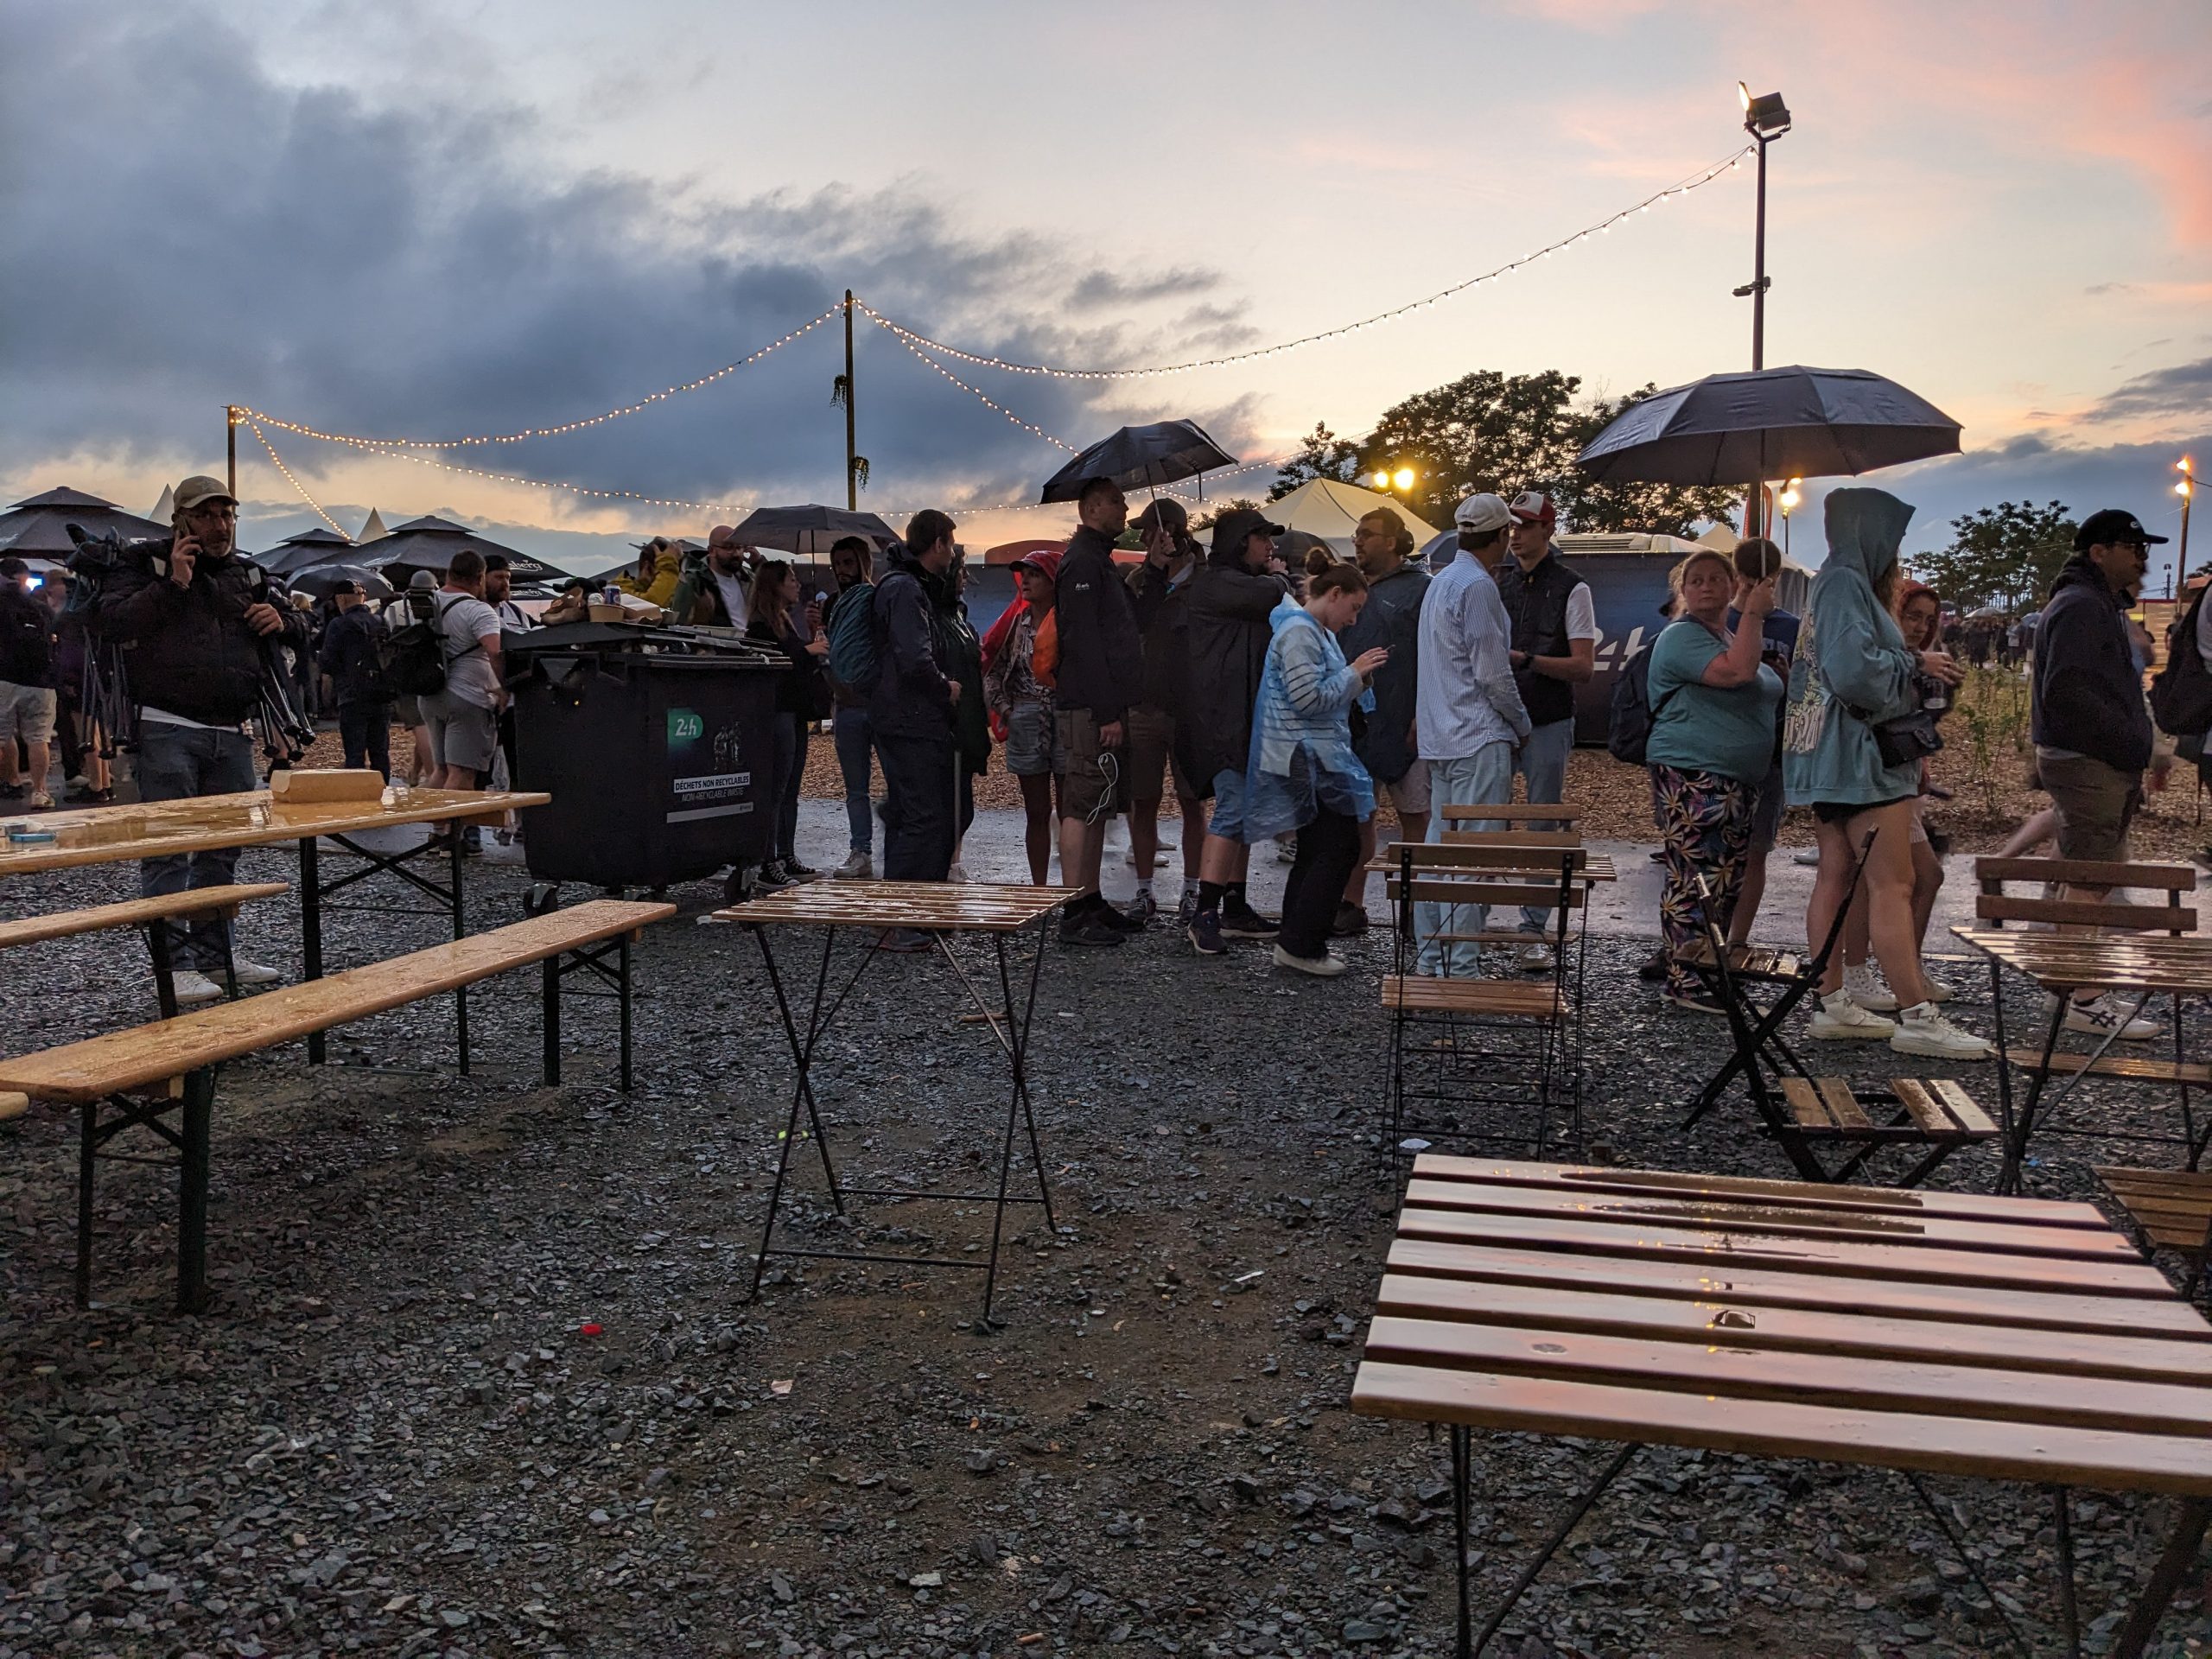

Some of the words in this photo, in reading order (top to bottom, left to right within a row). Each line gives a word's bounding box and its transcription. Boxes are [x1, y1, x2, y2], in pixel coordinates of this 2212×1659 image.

[675, 780, 702, 791] DÉCHETS
[702, 779, 715, 788] NON
[715, 776, 749, 786] RECYCLABLES
